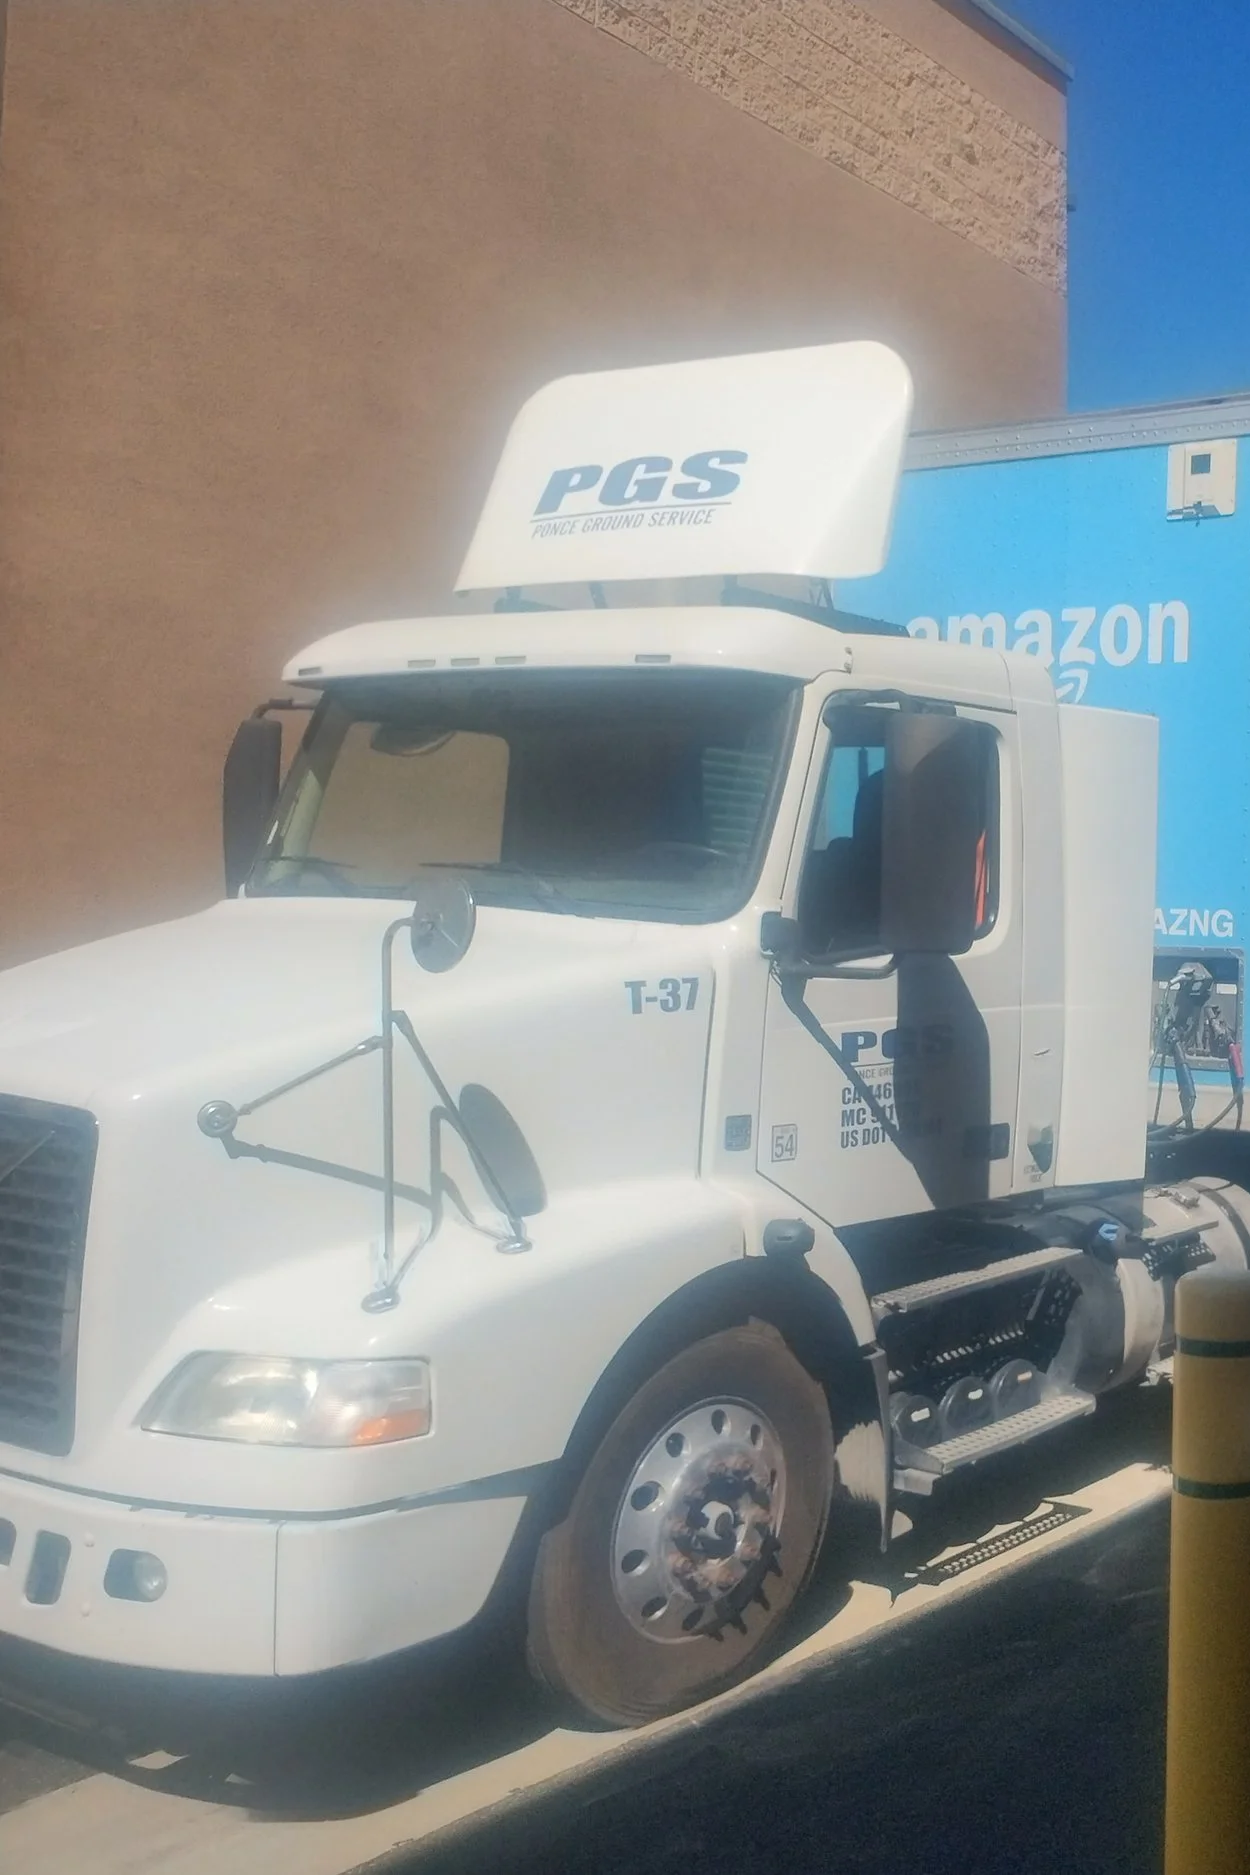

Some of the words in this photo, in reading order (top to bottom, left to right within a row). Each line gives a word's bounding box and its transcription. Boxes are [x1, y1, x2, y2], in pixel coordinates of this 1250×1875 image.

[533, 450, 748, 516] PGS
[531, 519, 578, 540] PONCE
[581, 512, 645, 534] GROUND
[648, 508, 717, 528] SERVICE
[624, 977, 699, 1015] T-37
[841, 1107, 867, 1127] MC
[774, 1133, 795, 1158] 54
[840, 1129, 859, 1149] US
